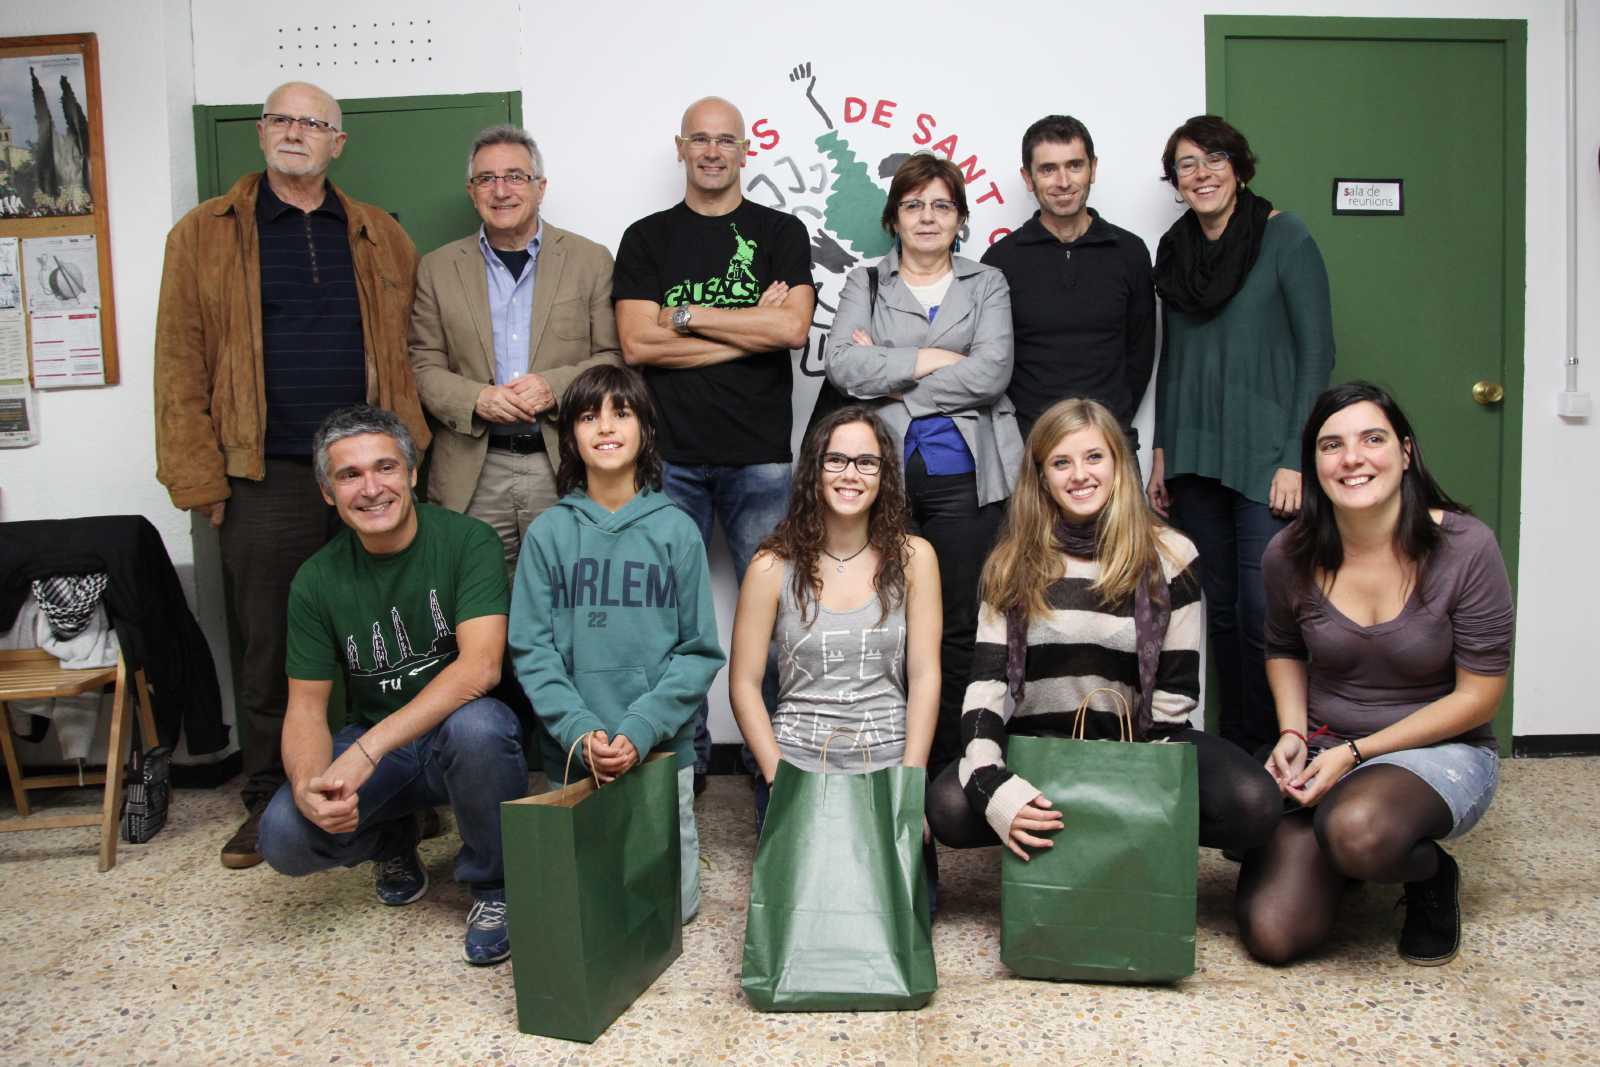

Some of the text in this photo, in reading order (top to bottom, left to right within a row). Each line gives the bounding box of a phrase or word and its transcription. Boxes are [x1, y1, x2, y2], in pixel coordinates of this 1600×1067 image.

[844, 97, 897, 128] DE
[912, 113, 1005, 204] SANT
[1343, 185, 1381, 197] sala de
[1348, 197, 1393, 207] reunions
[587, 611, 607, 628] 22
